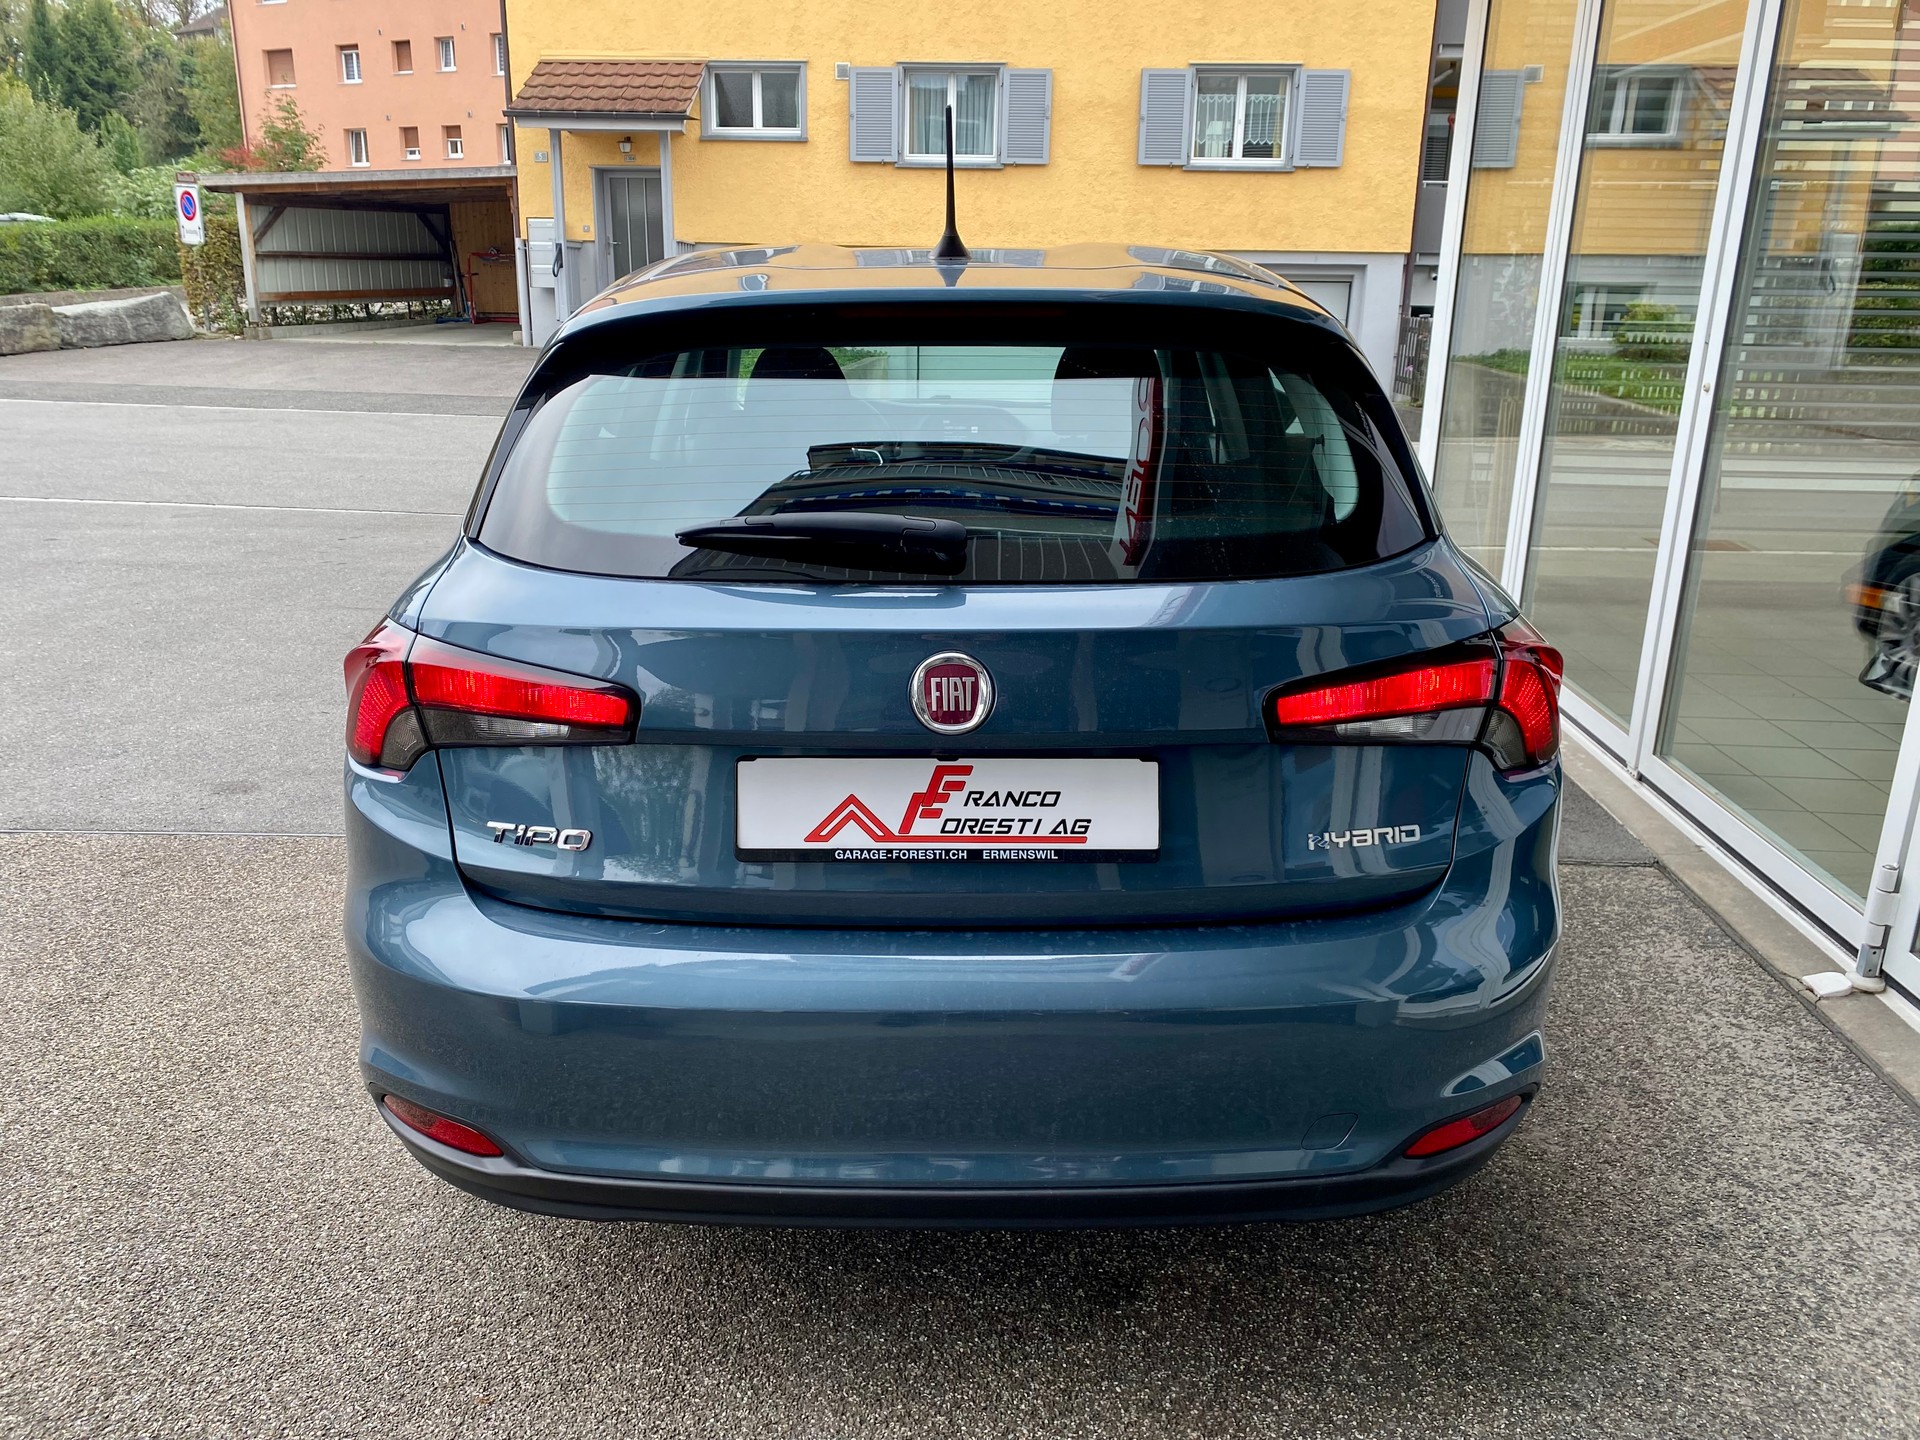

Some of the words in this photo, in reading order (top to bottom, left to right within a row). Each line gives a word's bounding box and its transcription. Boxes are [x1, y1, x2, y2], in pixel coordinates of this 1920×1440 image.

[930, 677, 976, 711] FIAT
[486, 820, 592, 851] TIPO
[1049, 818, 1092, 834] AG
[1307, 824, 1421, 850] HYBRID
[834, 849, 967, 860] GARAGE-FORESTI.CH
[982, 850, 1058, 860] ERMENSWIL
